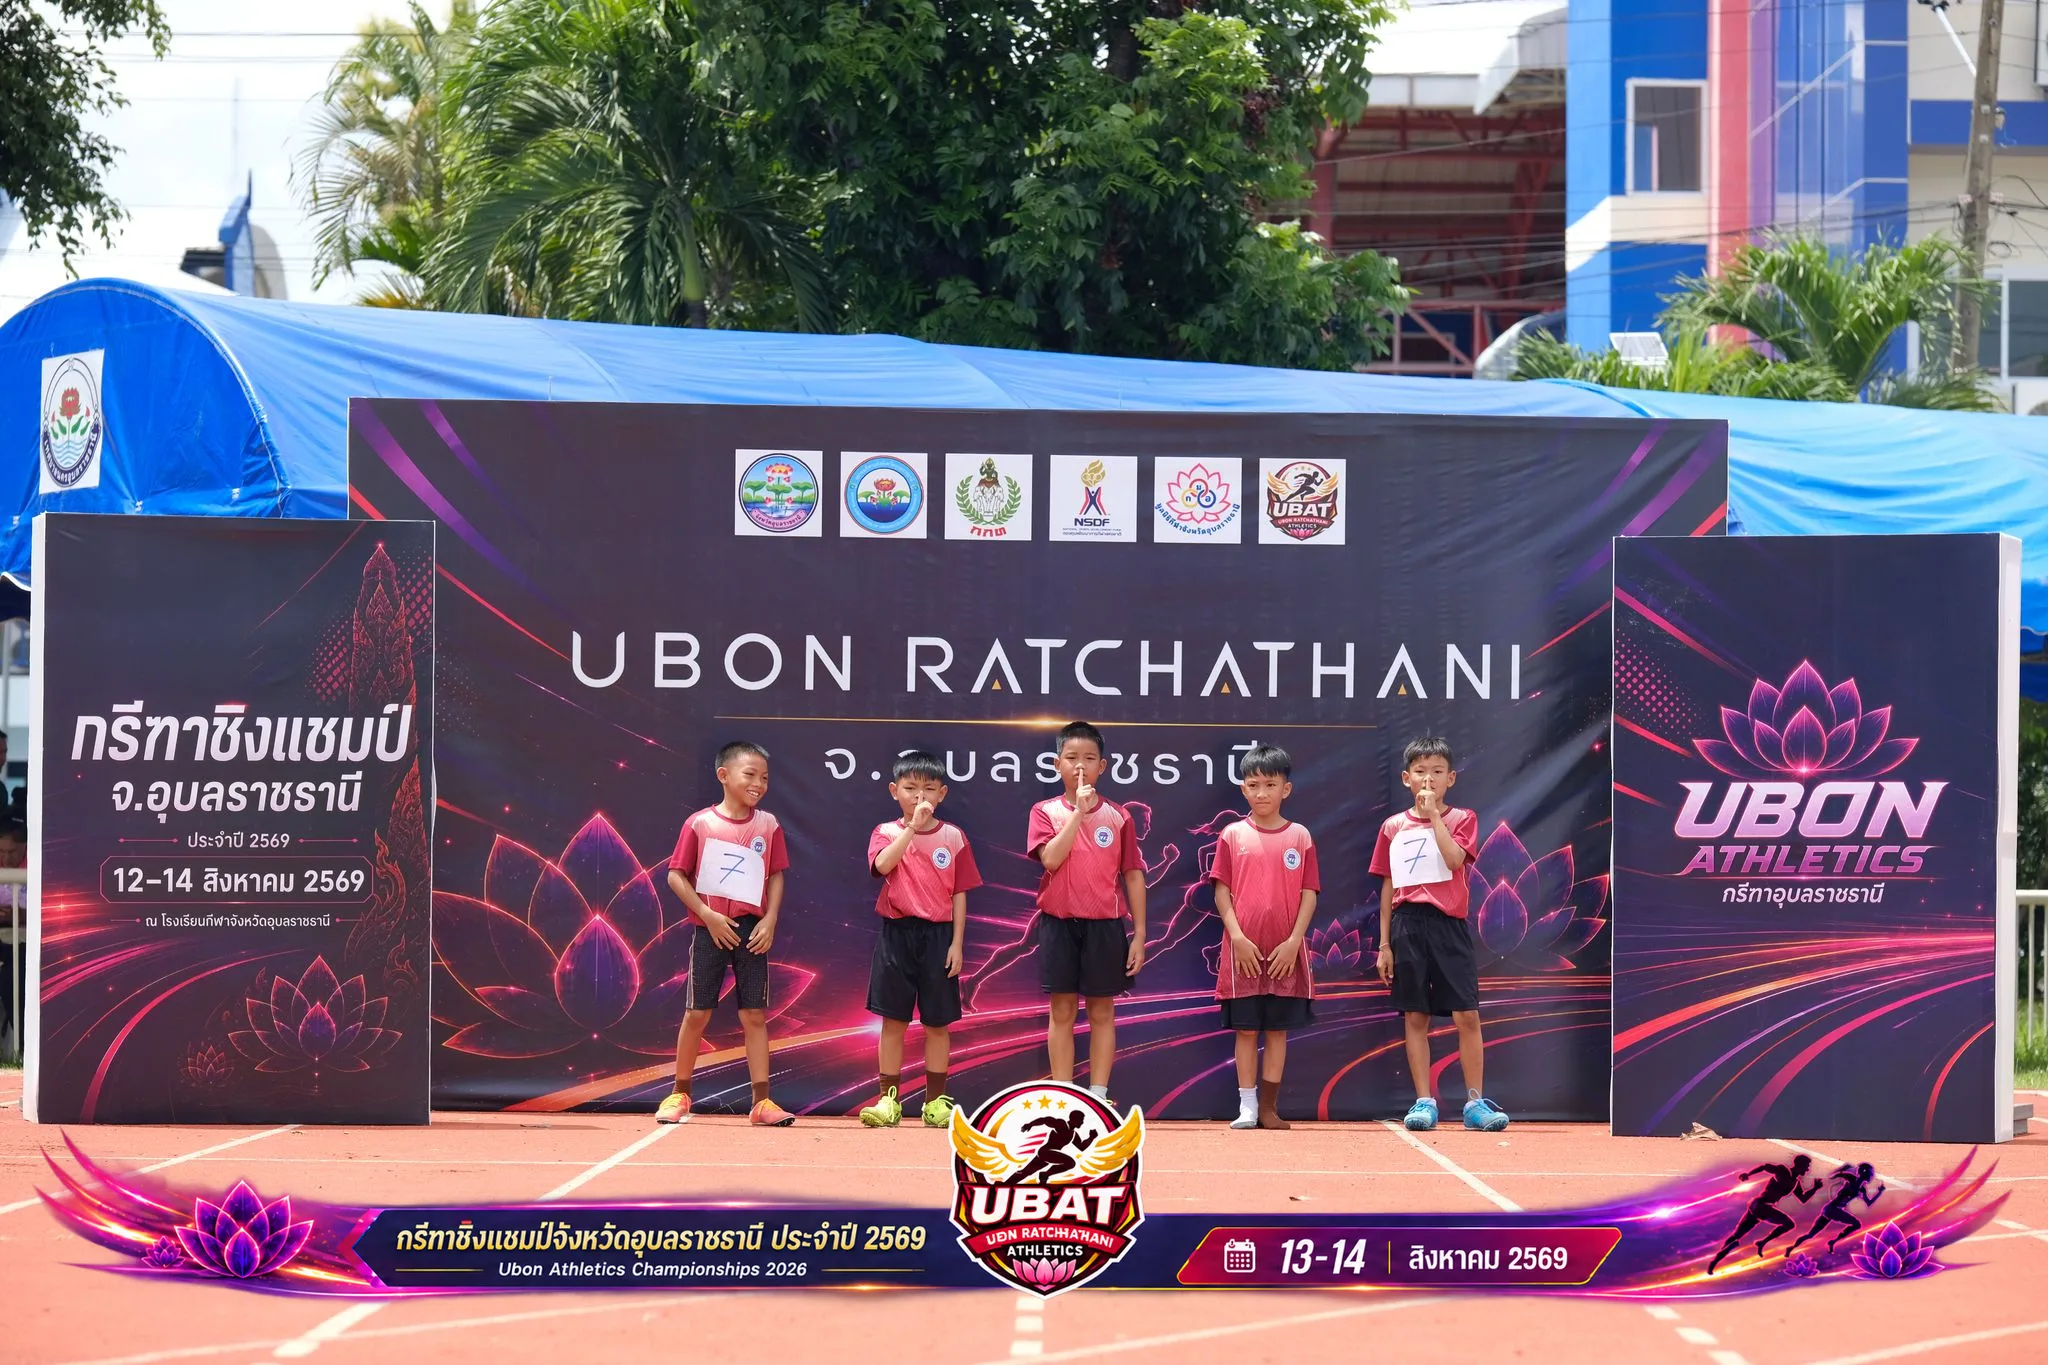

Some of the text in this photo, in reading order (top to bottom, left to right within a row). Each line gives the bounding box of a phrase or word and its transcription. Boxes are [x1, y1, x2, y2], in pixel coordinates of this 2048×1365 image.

[1074, 518, 1110, 527] NSDF
[1272, 502, 1332, 517] UBAT
[571, 631, 1521, 700] UBON RATCHATHANI
[71, 700, 413, 762] กรีฑาชิงแชมป์
[111, 771, 363, 824] จ.อุบลราชธานี
[1674, 781, 1950, 838] UBON
[187, 831, 290, 848] ประจำปี 2569
[720, 853, 745, 884] 7
[1403, 838, 1427, 874] 7
[1685, 844, 1935, 873] ATHLETICS
[203, 867, 295, 893] สิงหาคม
[303, 869, 365, 893] 2569
[1722, 882, 1886, 909] กรีฑาอุบลราชธานี
[145, 913, 330, 931] ณ โรงเรียนกีฬาจังหวัดอุบลราชธานี
